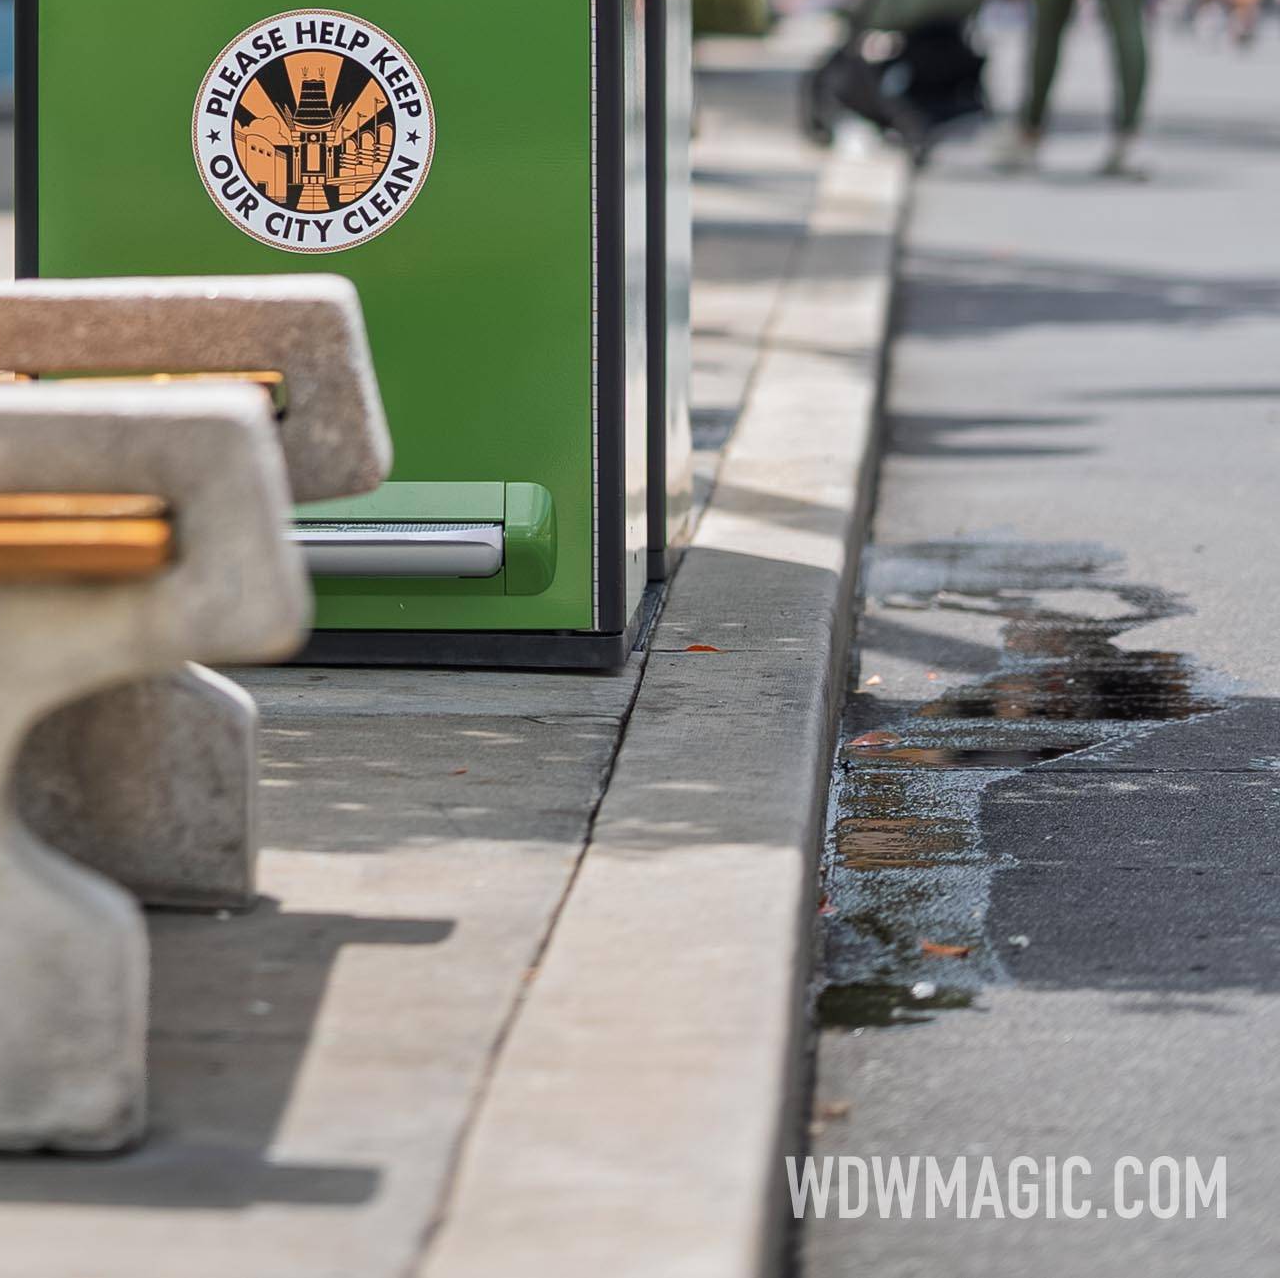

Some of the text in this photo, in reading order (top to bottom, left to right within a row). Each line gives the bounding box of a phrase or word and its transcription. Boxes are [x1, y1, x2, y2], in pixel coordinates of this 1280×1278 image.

[205, 20, 422, 119] PLEASE HELP KEEP
[209, 154, 420, 243] OUR CITY CLEAN
